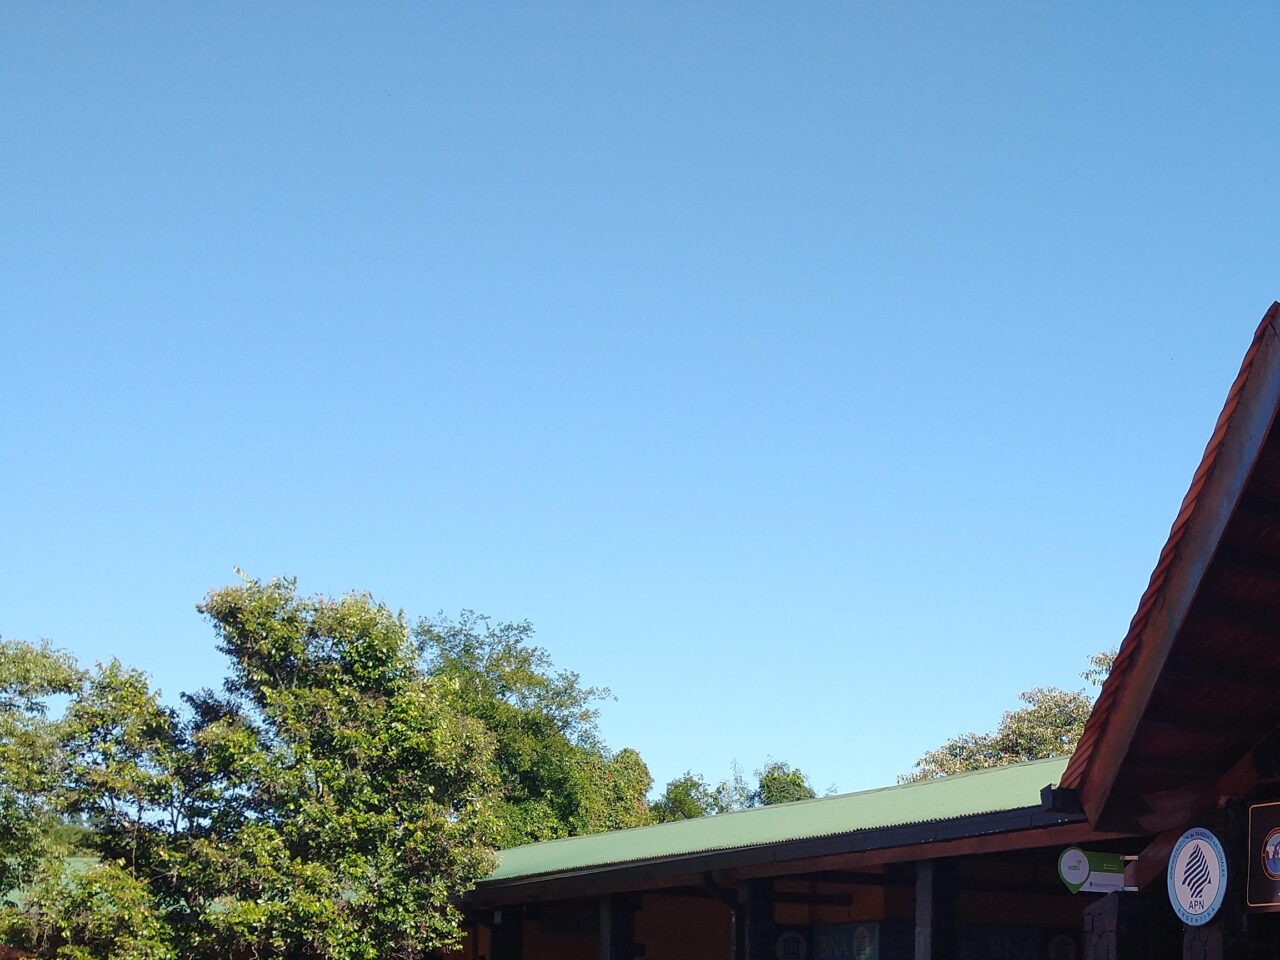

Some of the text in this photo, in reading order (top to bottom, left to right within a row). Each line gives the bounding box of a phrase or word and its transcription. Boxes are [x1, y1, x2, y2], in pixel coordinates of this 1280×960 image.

[1177, 907, 1216, 922] ARGENTINA
[1188, 900, 1205, 910] APN
[819, 935, 849, 958] BNA
[989, 935, 1040, 960] BNA
